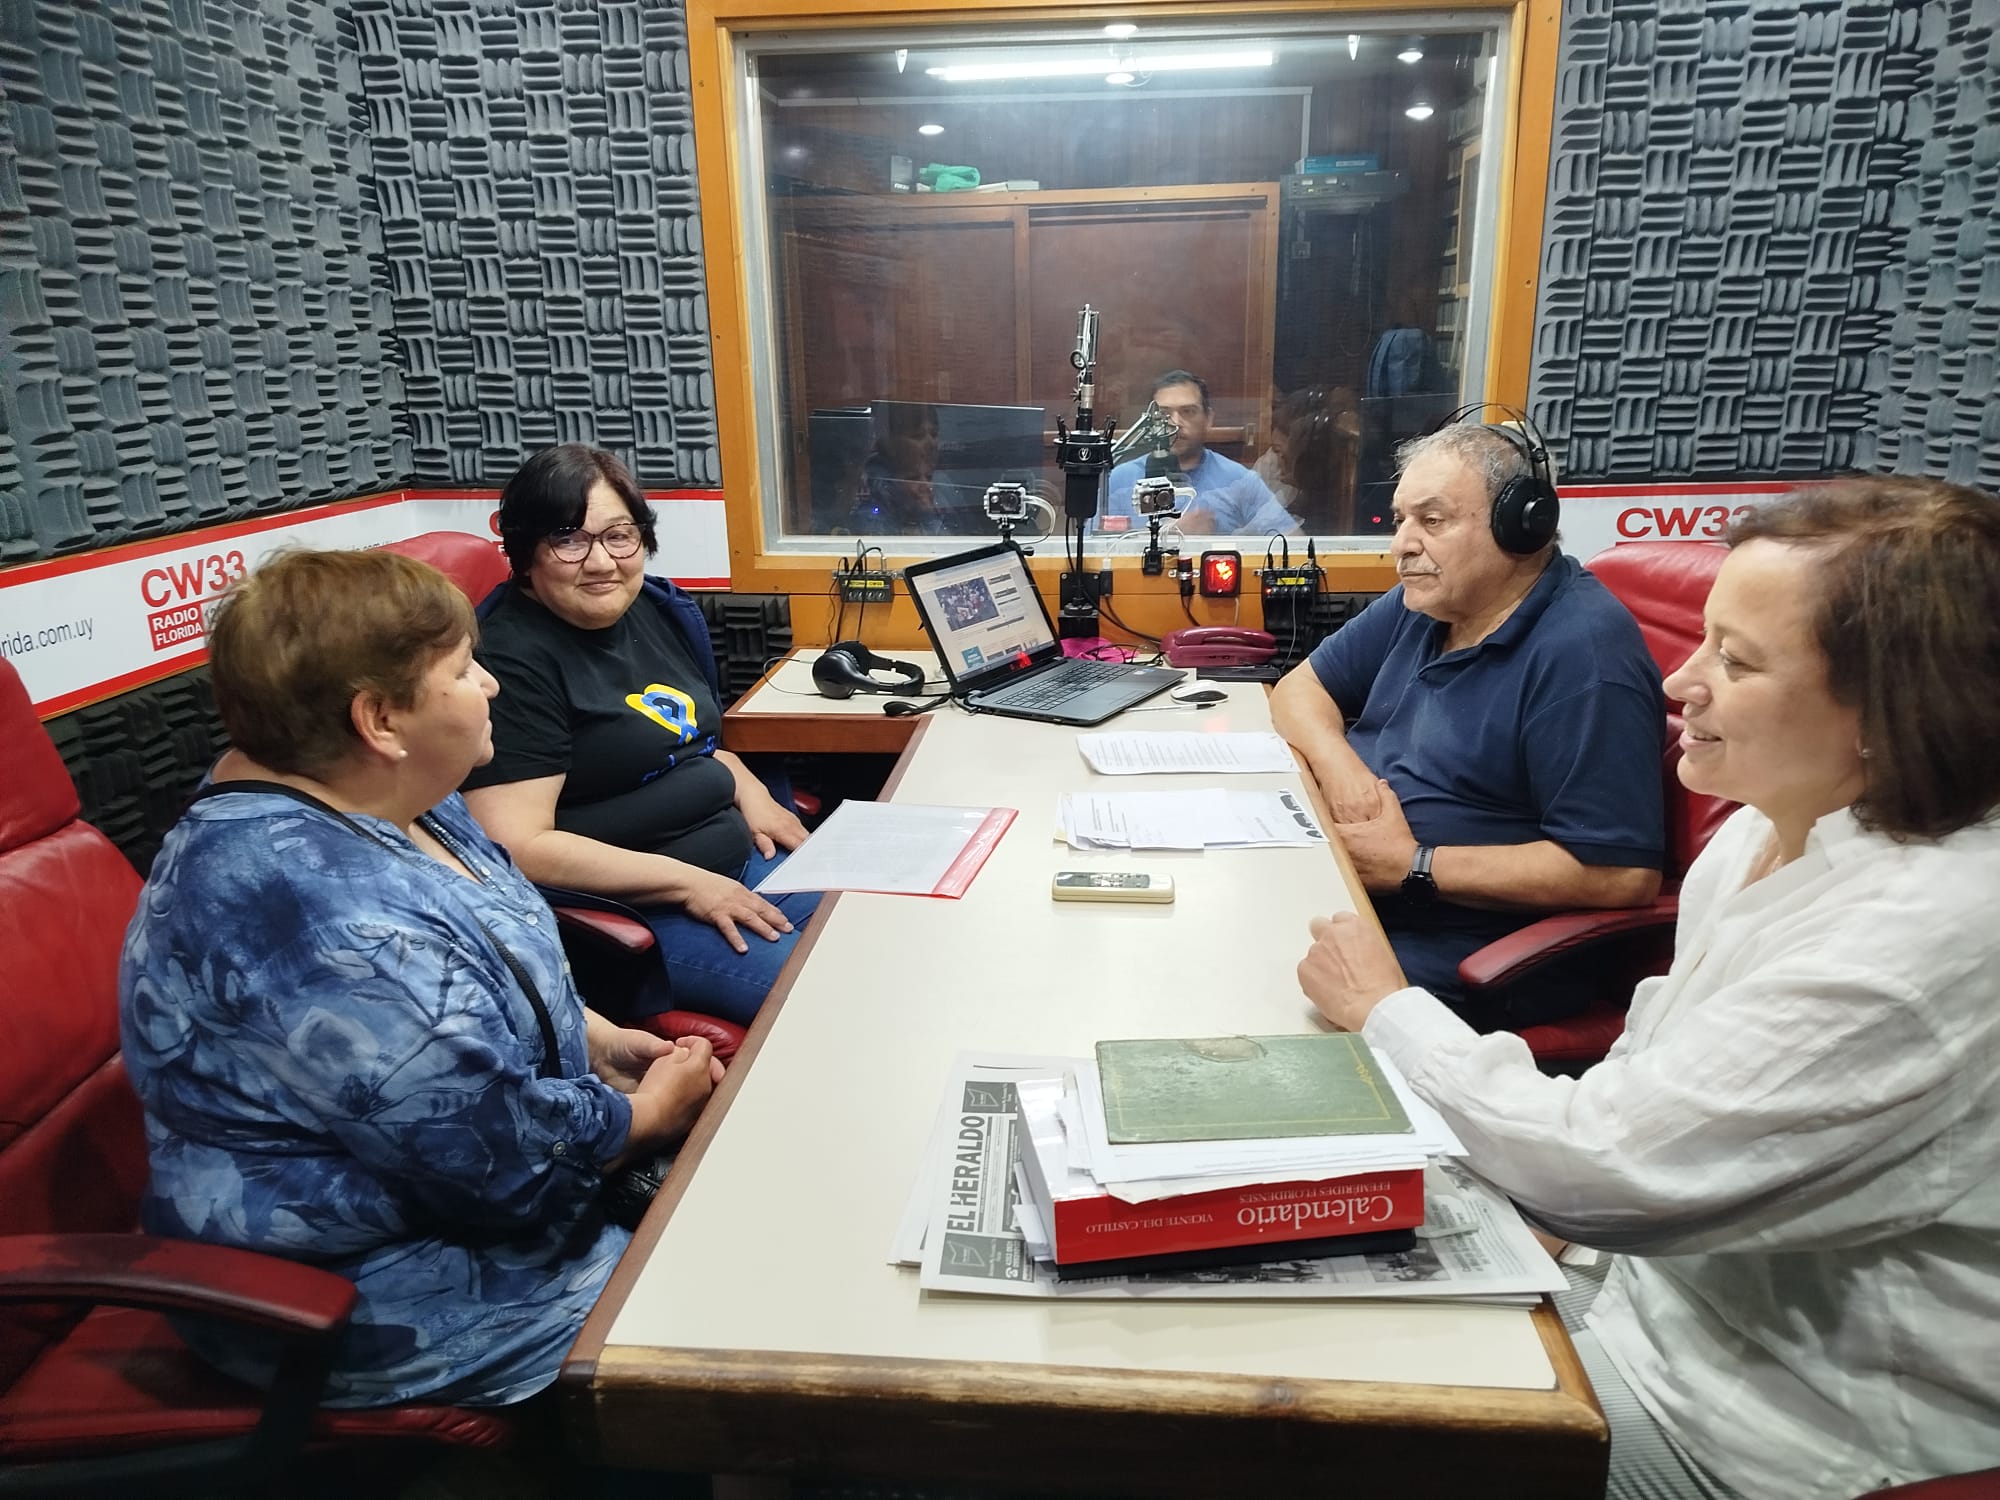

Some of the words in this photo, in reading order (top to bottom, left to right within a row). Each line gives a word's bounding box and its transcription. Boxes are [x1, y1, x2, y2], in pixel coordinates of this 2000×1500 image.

[141, 550, 248, 608] CW33
[152, 607, 199, 631] RADIO
[0, 617, 94, 658] rida.com.uy
[155, 622, 203, 646] FLORIDA
[950, 1115, 986, 1207] HERALDO
[946, 1210, 976, 1232] EL
[1141, 1217, 1164, 1230] DEL
[1166, 1213, 1214, 1227] VICENTE
[1237, 1195, 1394, 1233] Calendario
[1086, 1220, 1139, 1234] CASTILLO
